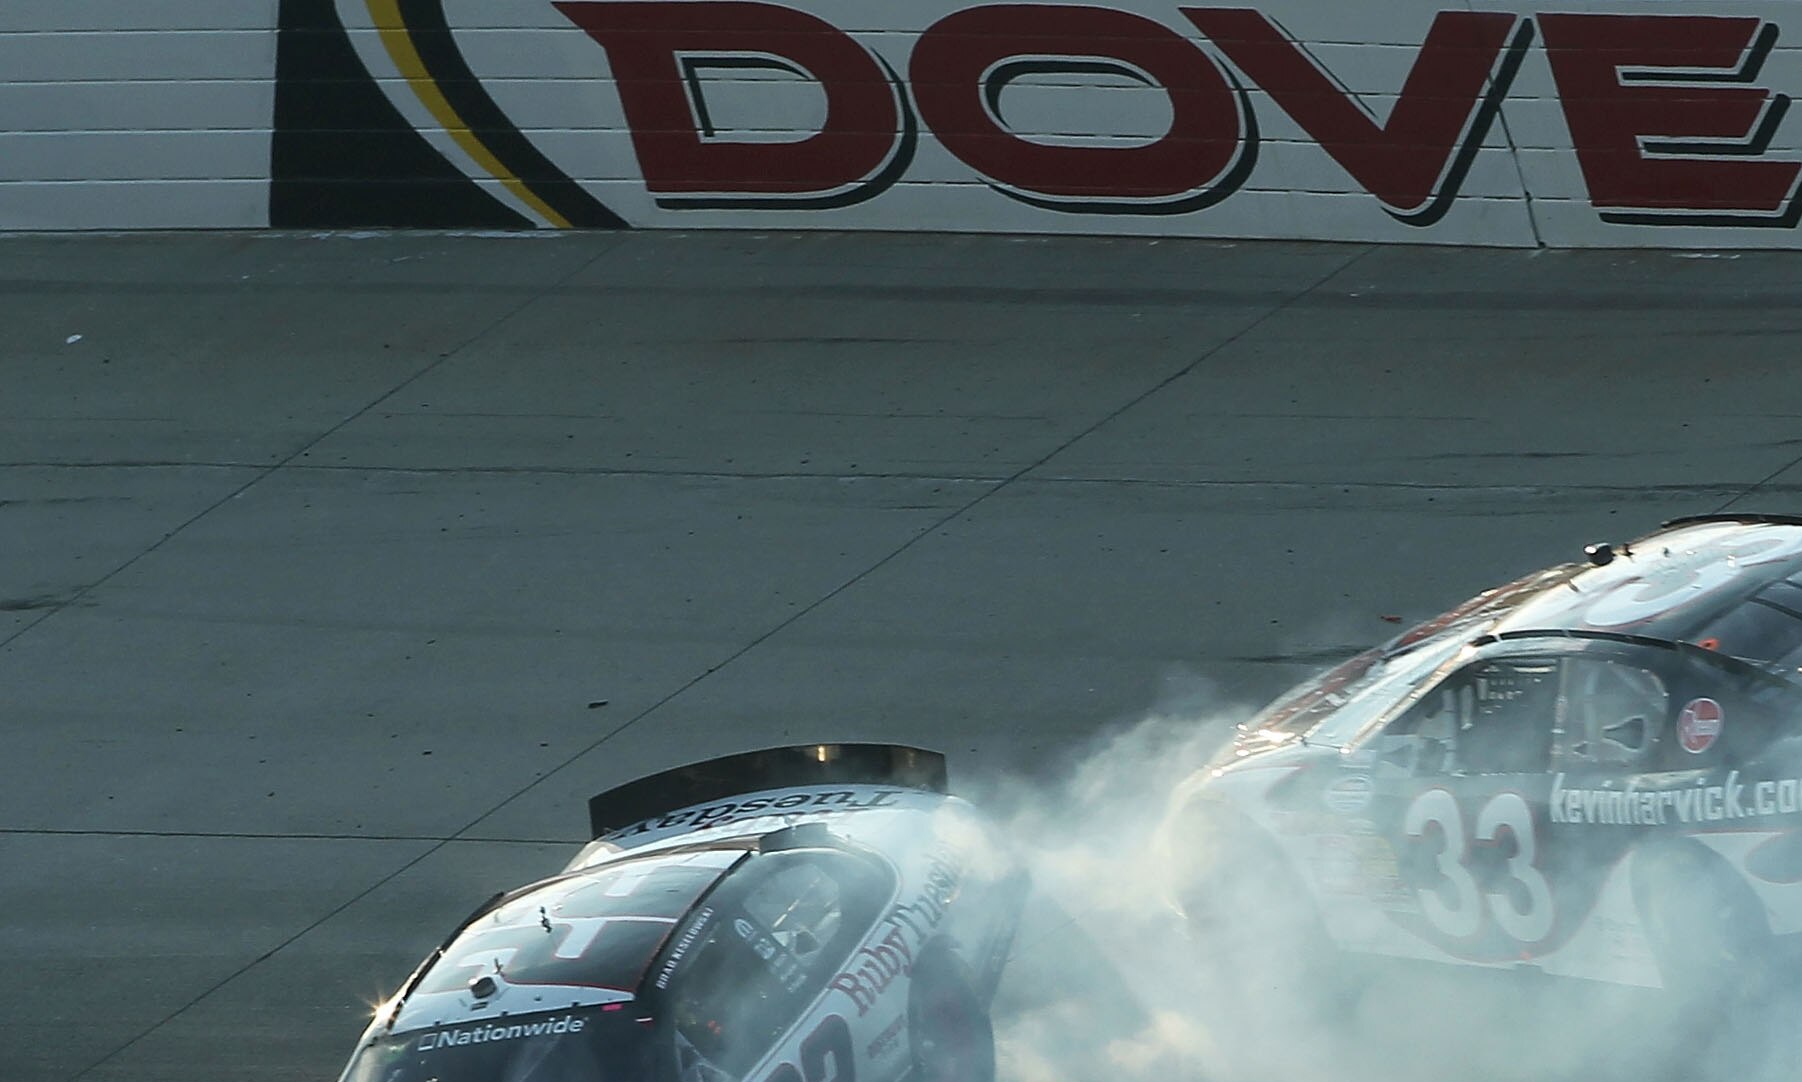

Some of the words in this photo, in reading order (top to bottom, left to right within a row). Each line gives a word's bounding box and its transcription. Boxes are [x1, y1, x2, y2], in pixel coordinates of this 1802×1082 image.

[1404, 787, 1555, 943] 33
[831, 926, 912, 1018] Ruby
[438, 1015, 586, 1048] Nationwide
